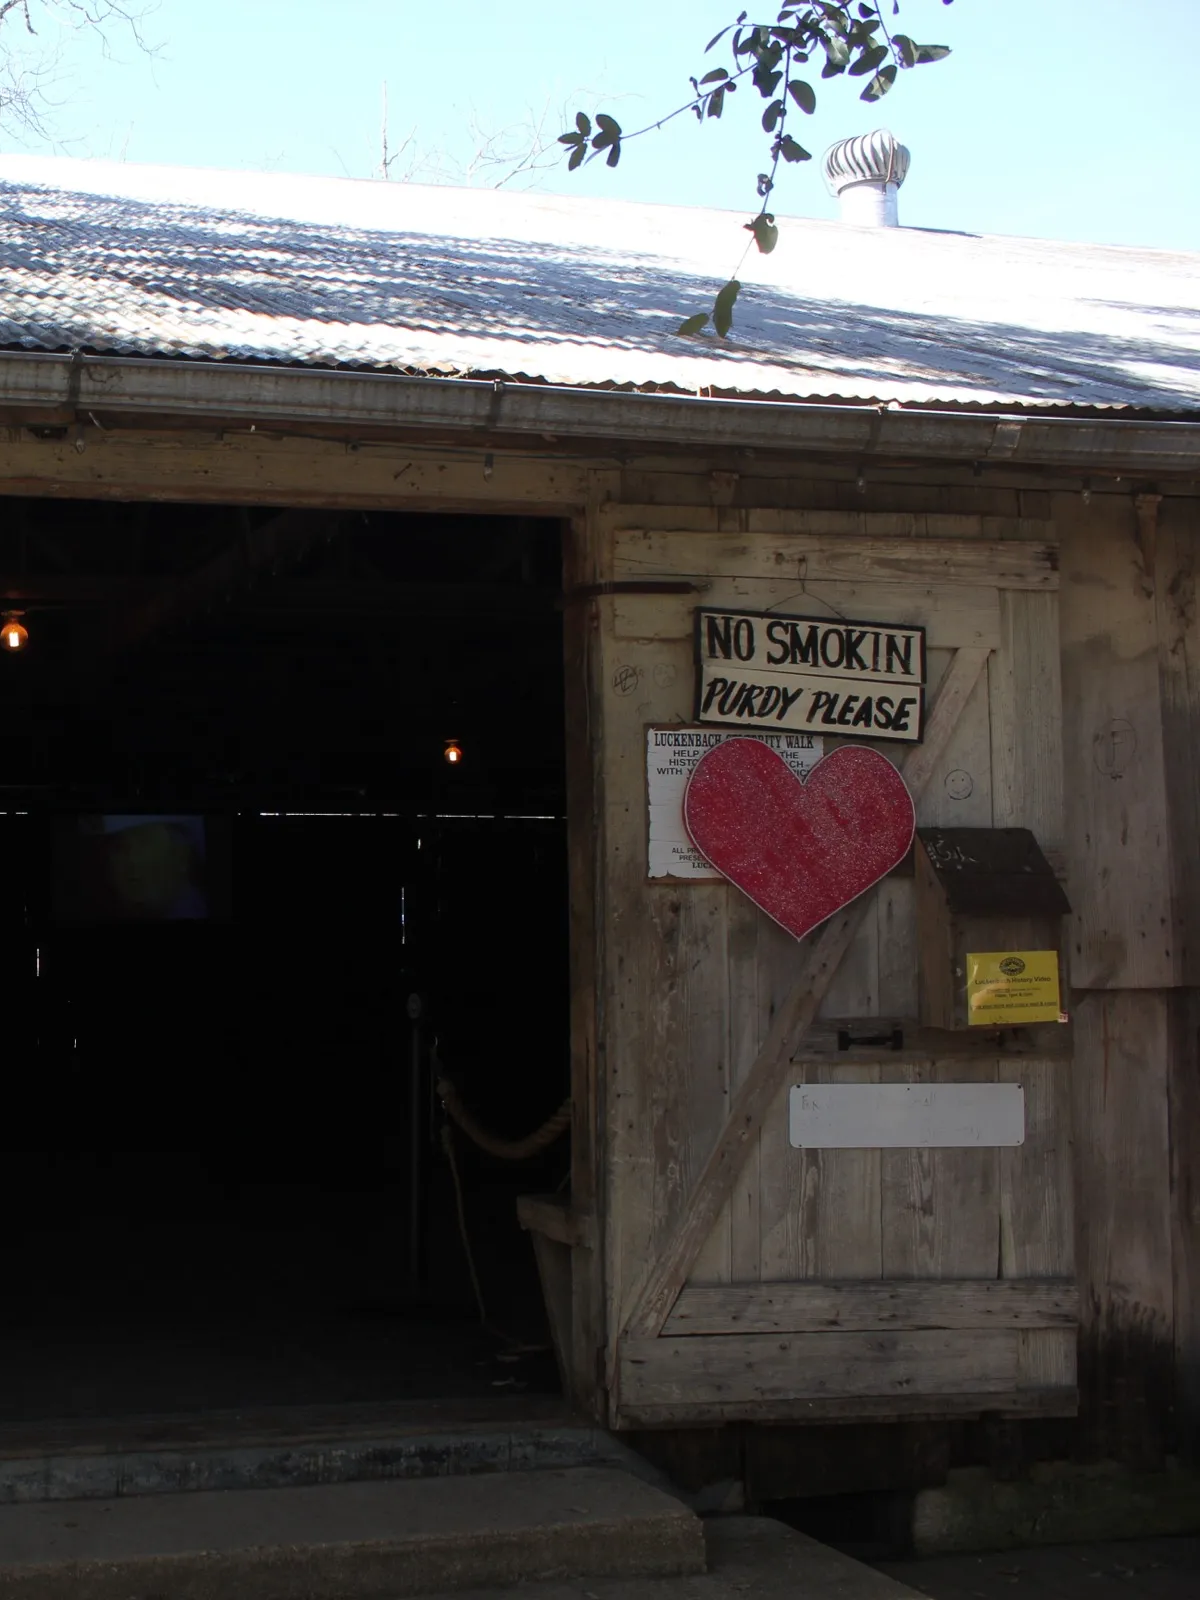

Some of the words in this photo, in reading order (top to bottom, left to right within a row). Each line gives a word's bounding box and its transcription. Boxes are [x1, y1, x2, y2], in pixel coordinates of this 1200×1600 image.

[706, 615, 755, 662] NO
[767, 620, 913, 676] SMOKIN
[701, 677, 804, 719] PURDY
[807, 692, 917, 732] PLEASE
[785, 735, 814, 749] WALK
[673, 749, 700, 758] HELP
[780, 751, 799, 759] THE
[669, 758, 697, 767] HISTO
[656, 767, 683, 775] WITH
[1033, 975, 1052, 983] Video
